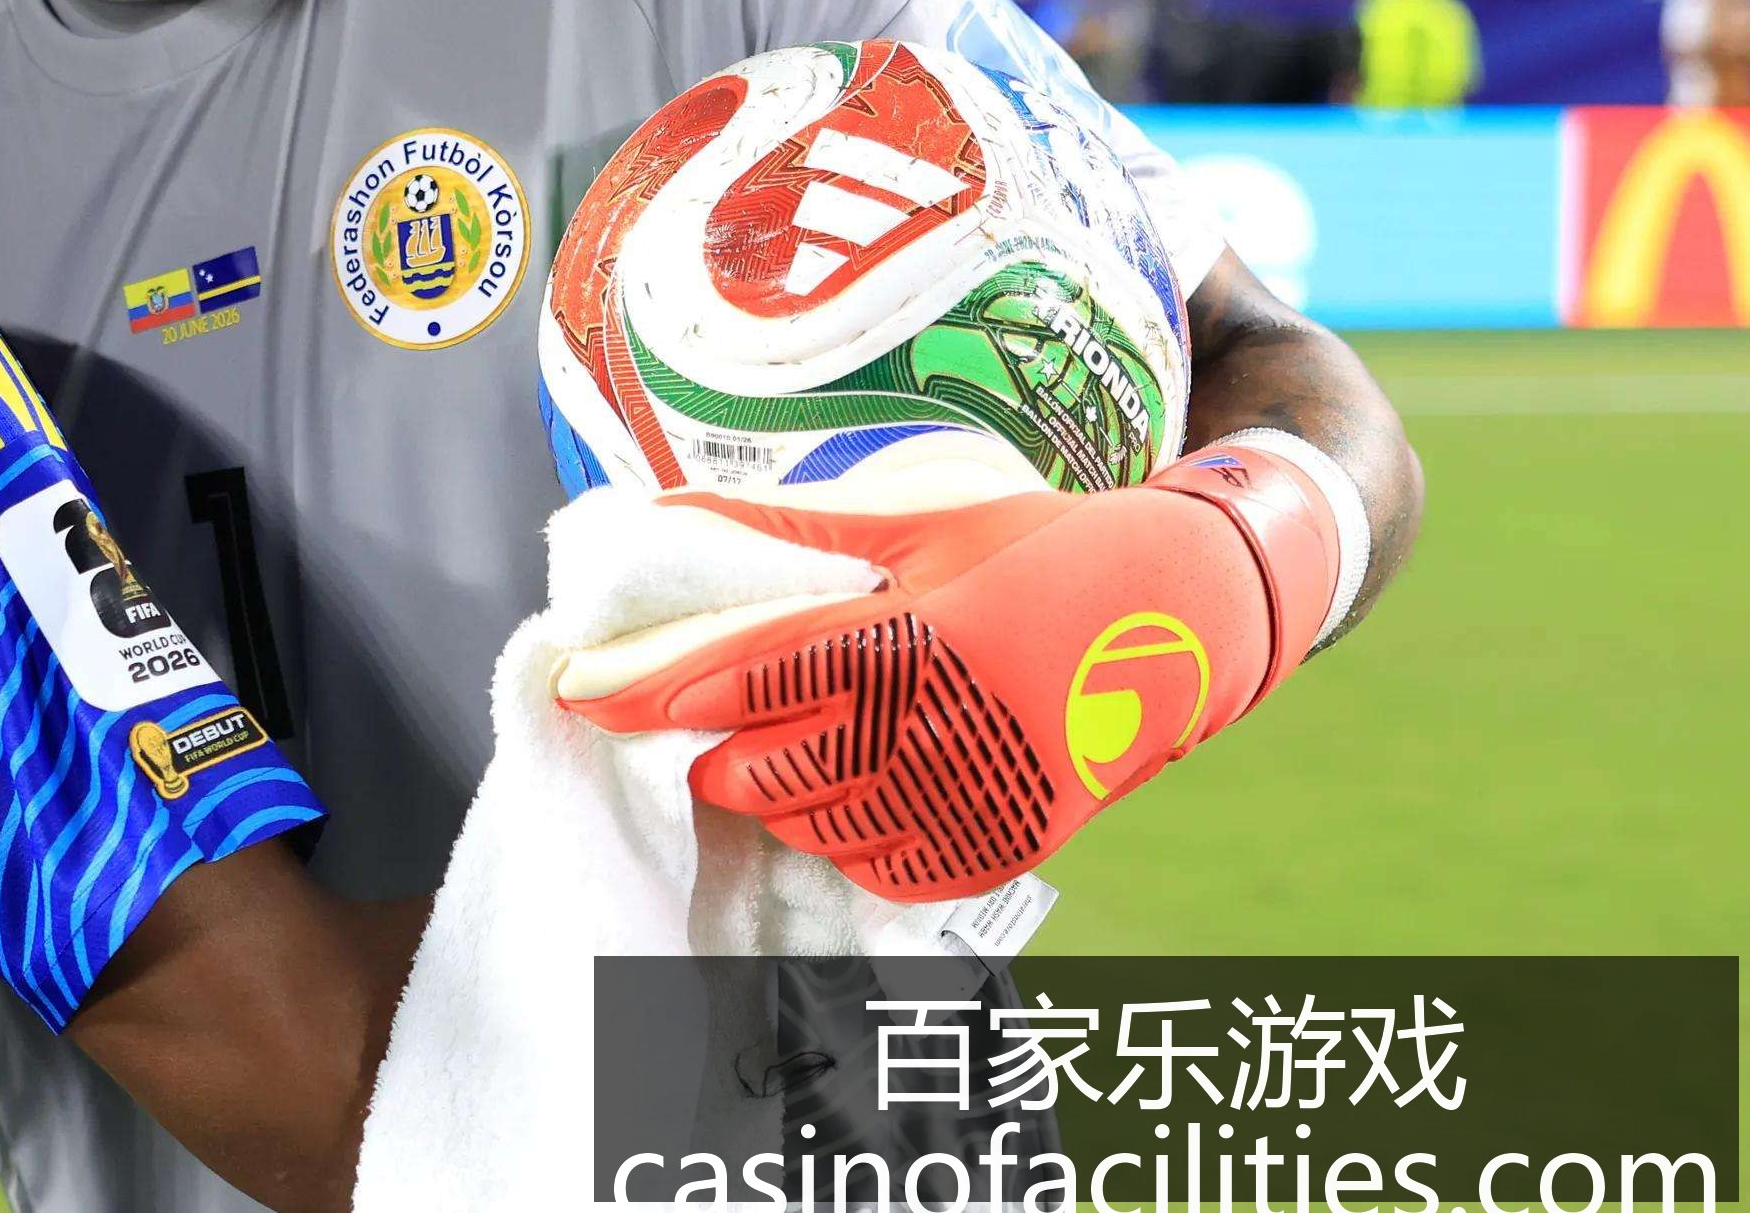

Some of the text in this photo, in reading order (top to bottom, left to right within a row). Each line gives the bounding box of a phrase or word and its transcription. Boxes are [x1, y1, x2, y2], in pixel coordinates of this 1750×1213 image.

[343, 159, 395, 326] Federashon
[178, 316, 209, 341] JUNE
[210, 307, 241, 330] 2026
[1021, 404, 1054, 439] BALLON
[1050, 436, 1063, 449] DE
[1059, 445, 1083, 476] MATCH
[1048, 416, 1078, 453] OFFICIAL
[1076, 449, 1100, 481] MATCH
[1128, 431, 1141, 453] PRO
[1084, 441, 1097, 460] DEL
[1094, 456, 1114, 489] PARTIDO
[125, 602, 161, 624] FIFA
[184, 467, 295, 739] 1
[119, 636, 169, 661] WORLD
[128, 647, 201, 684] 2026
[172, 713, 245, 755] DEBUT
[184, 730, 249, 763] FIFA WORLD CUP
